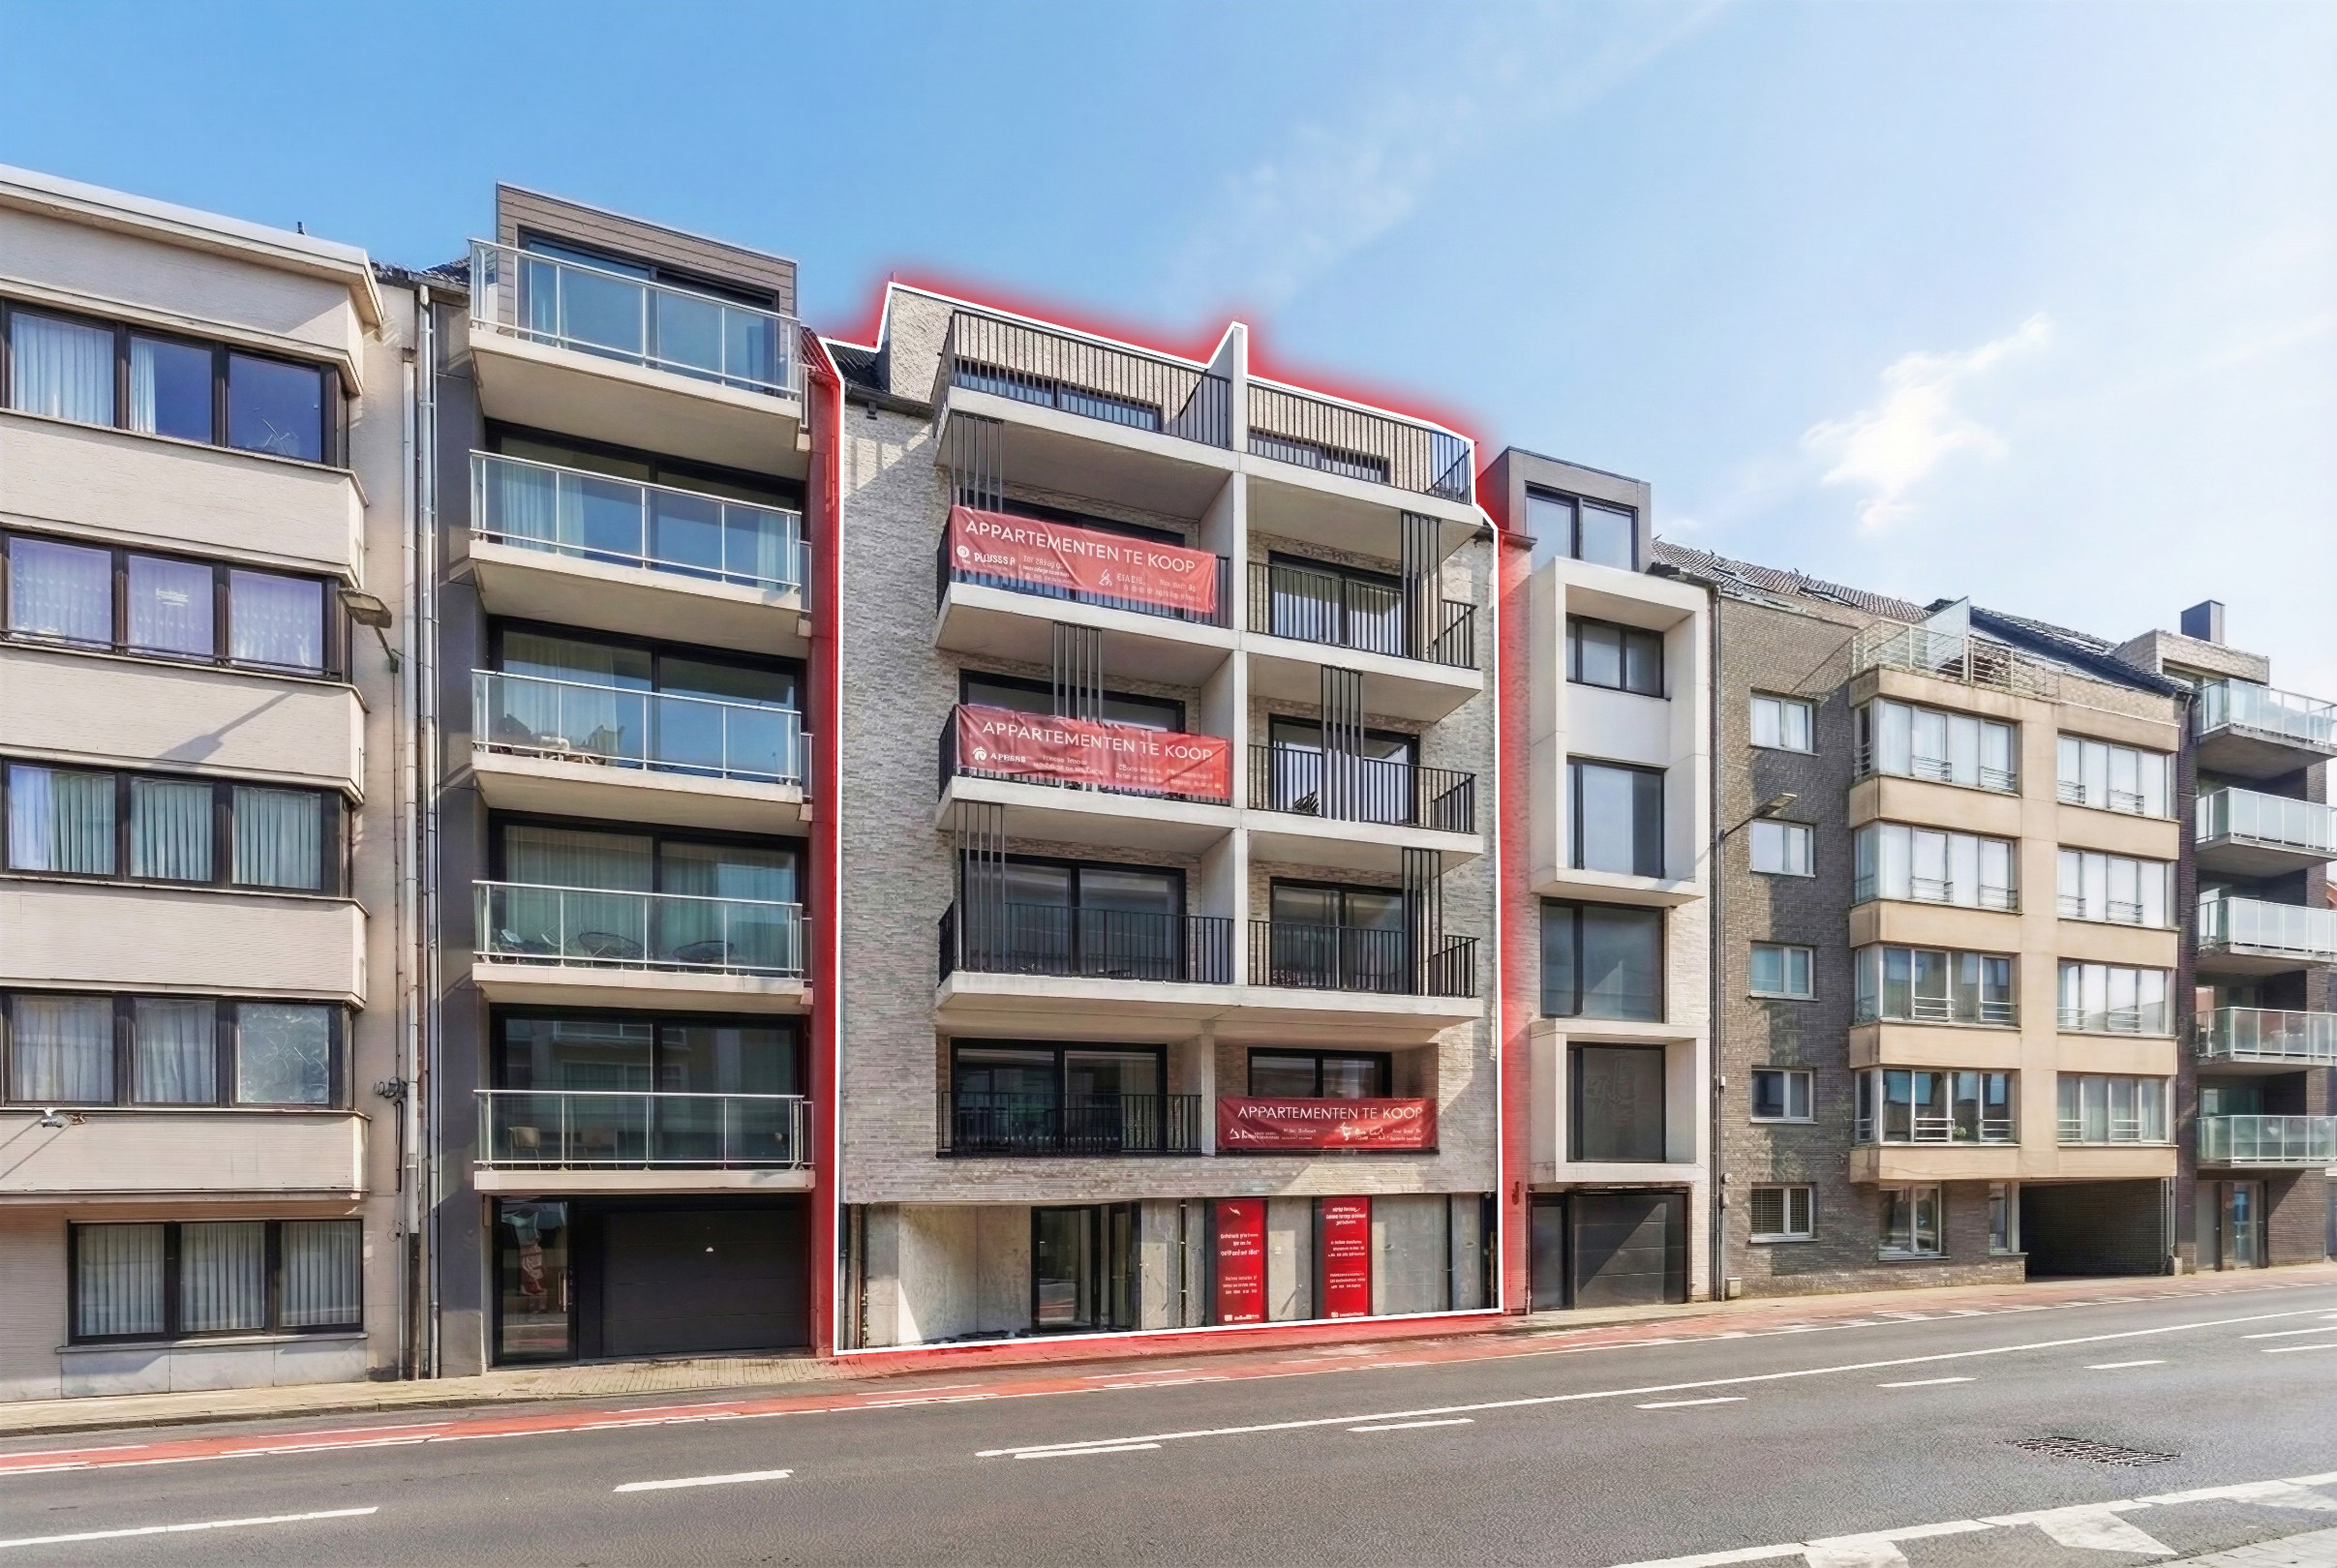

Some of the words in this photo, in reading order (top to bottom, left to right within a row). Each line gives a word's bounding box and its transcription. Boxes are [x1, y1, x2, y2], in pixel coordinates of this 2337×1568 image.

[965, 520, 1119, 561] APPARTEMENTEN
[1123, 548, 1143, 565] TE
[1148, 553, 1196, 573] KOOP
[982, 721, 1135, 753] APPARTEMENTEN
[1139, 740, 1160, 756] TE
[1165, 744, 1213, 762] KOOP
[1237, 1105, 1358, 1119] APPARTEMENTEN
[1362, 1107, 1378, 1119] TE
[1382, 1106, 1423, 1119] KOOP
